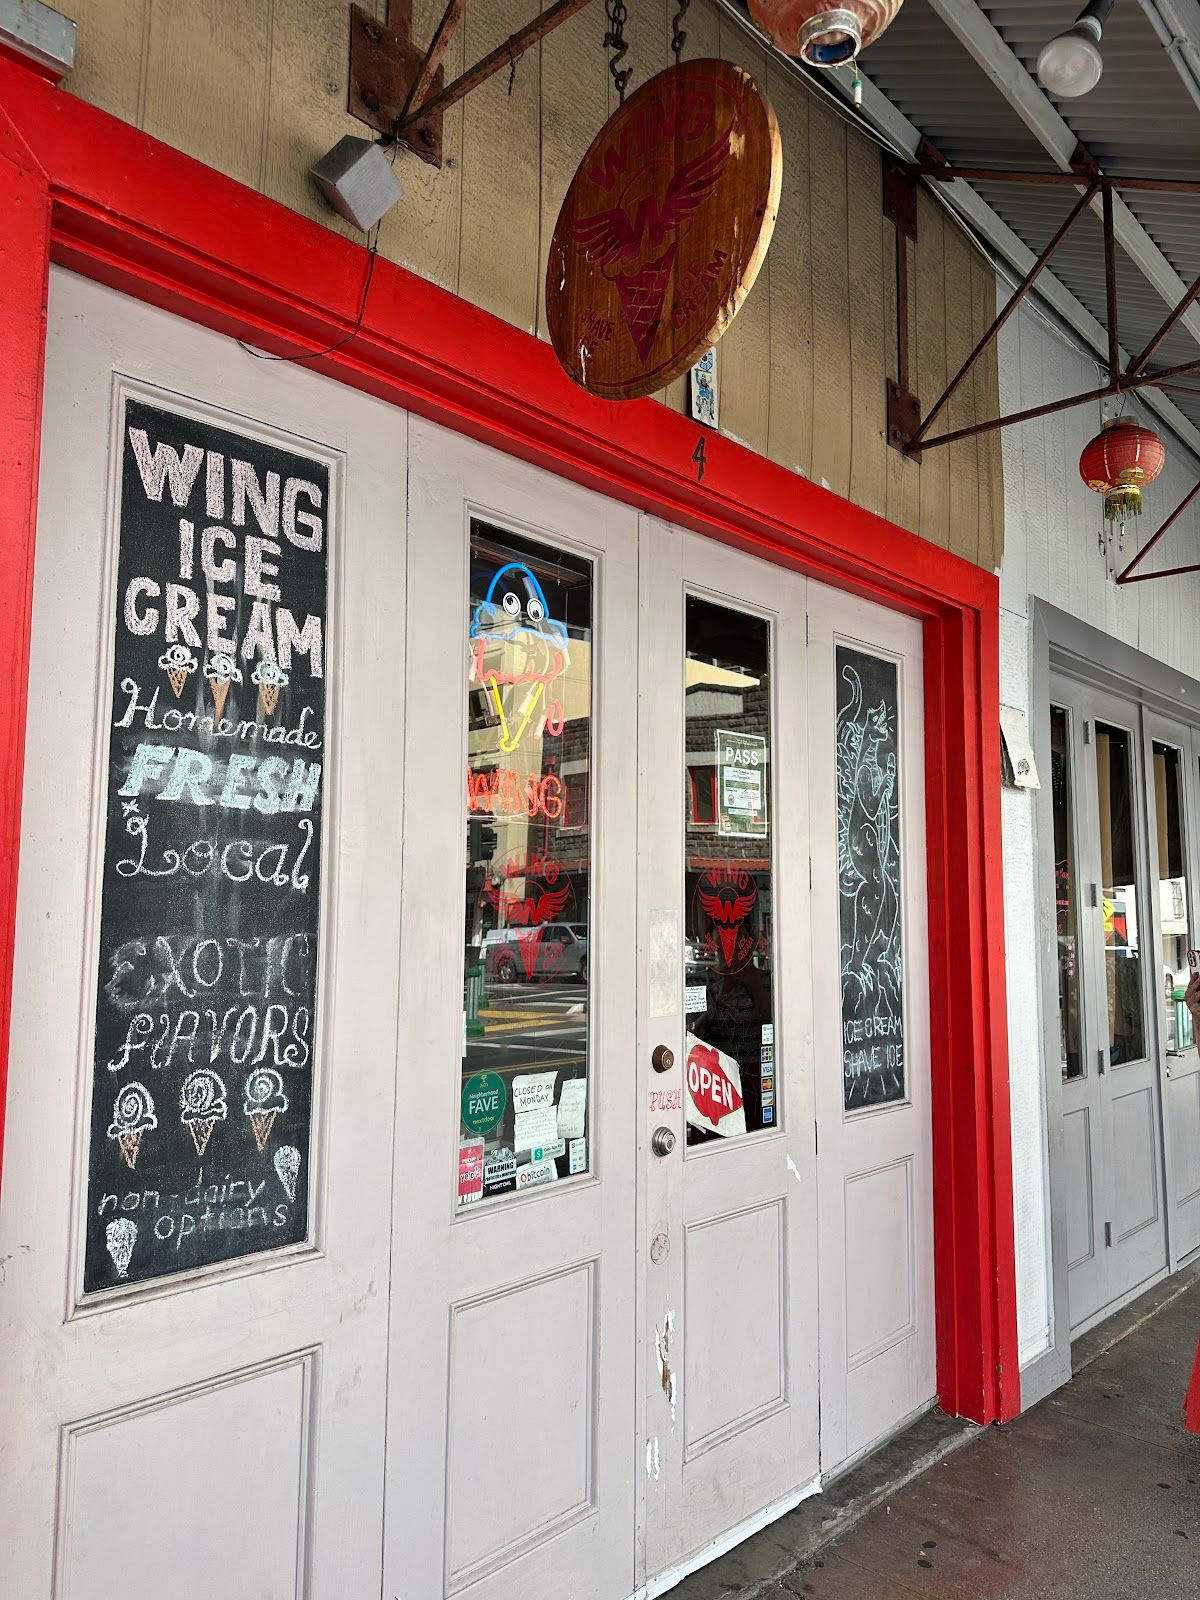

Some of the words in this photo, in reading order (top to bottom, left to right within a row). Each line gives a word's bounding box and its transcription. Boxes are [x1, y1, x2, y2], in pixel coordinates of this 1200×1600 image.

[589, 90, 715, 191] WING
[691, 436, 706, 481] 4
[129, 427, 323, 552] WING
[179, 519, 281, 601] ICE
[124, 577, 323, 678] CREAM
[114, 677, 322, 749] Homemade
[726, 746, 759, 766] PASS
[118, 744, 322, 815] FRESH
[467, 764, 562, 819] WING
[115, 815, 314, 894] Local
[499, 851, 560, 884] WING
[706, 863, 749, 890] WING
[843, 1020, 863, 1044] ICE
[864, 1015, 903, 1039] CREAM
[844, 1045, 881, 1078] SHAVE
[886, 1044, 903, 1069] ICE
[513, 1084, 543, 1098] CLOSED
[519, 1093, 550, 1107] MONDAY
[648, 1088, 682, 1112] PUSH
[688, 1061, 734, 1111] OPEN
[469, 1096, 499, 1114] FAVE
[460, 1171, 475, 1184] yelp
[487, 1162, 514, 1174] WARNING
[527, 1166, 550, 1181] bitcoin
[154, 1203, 289, 1250] options
